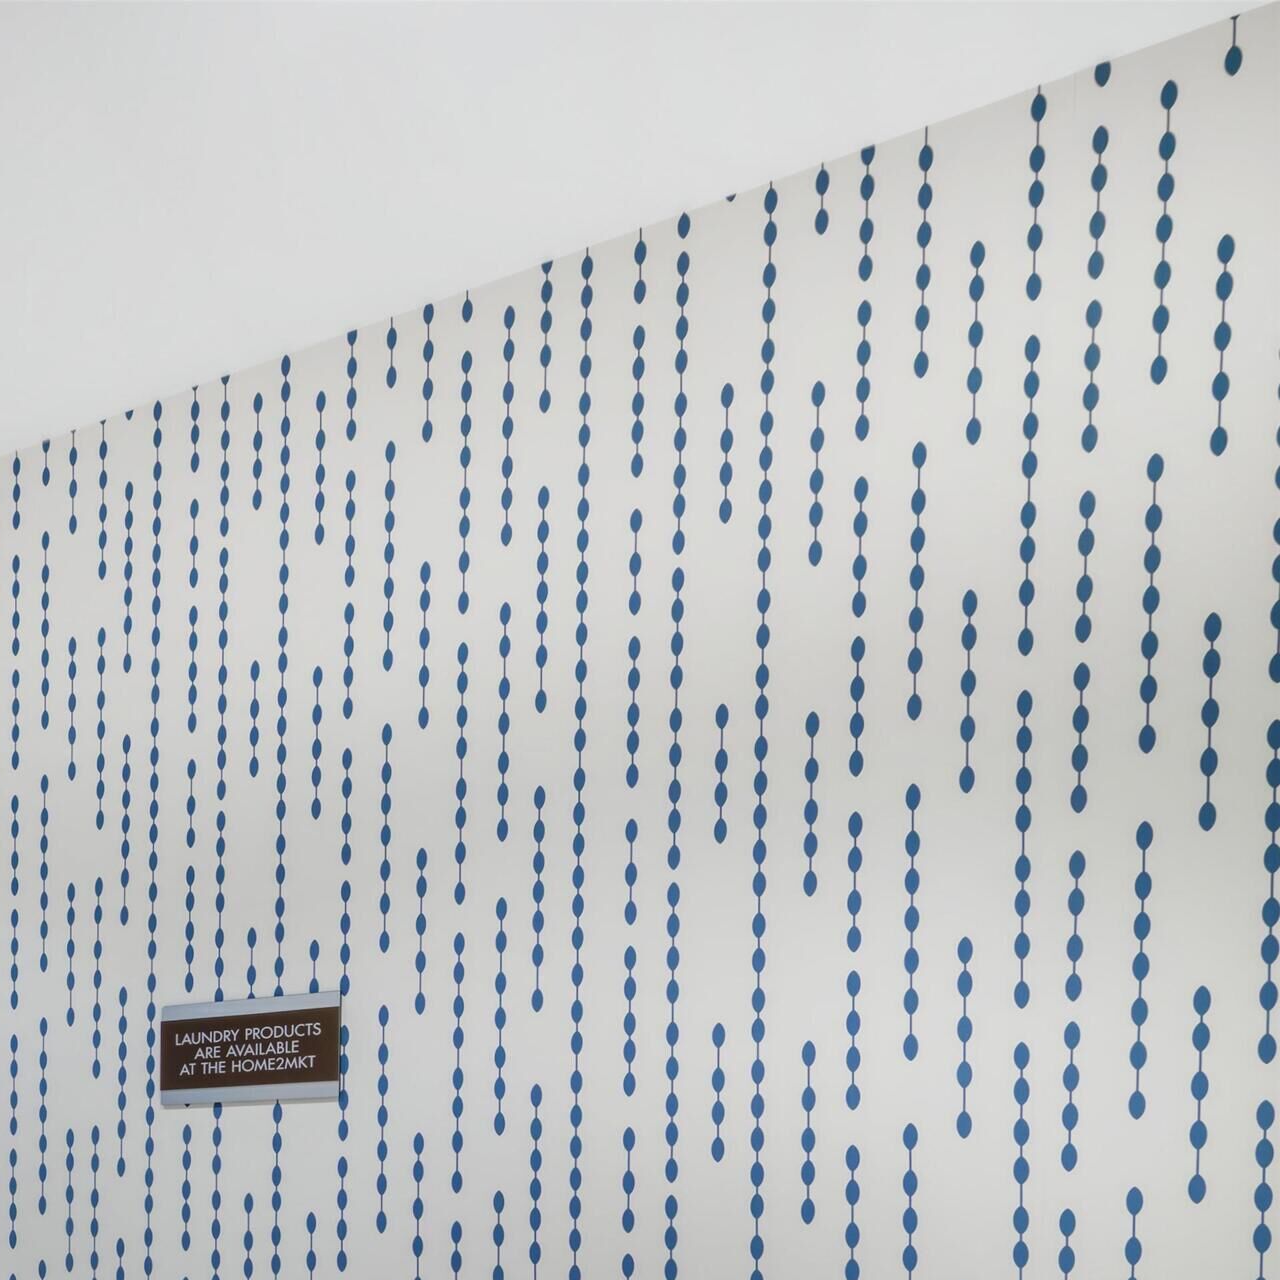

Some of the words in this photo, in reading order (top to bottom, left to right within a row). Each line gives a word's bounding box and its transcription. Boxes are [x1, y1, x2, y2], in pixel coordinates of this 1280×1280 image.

[175, 1028, 240, 1046] LAUNDRY
[245, 1022, 321, 1041] PRODUCTS
[194, 1047, 221, 1060] ARE
[226, 1040, 299, 1057] AVAILABLE
[179, 1064, 196, 1076] AT
[201, 1062, 226, 1074] THE
[231, 1055, 316, 1072] HOME2MKT
